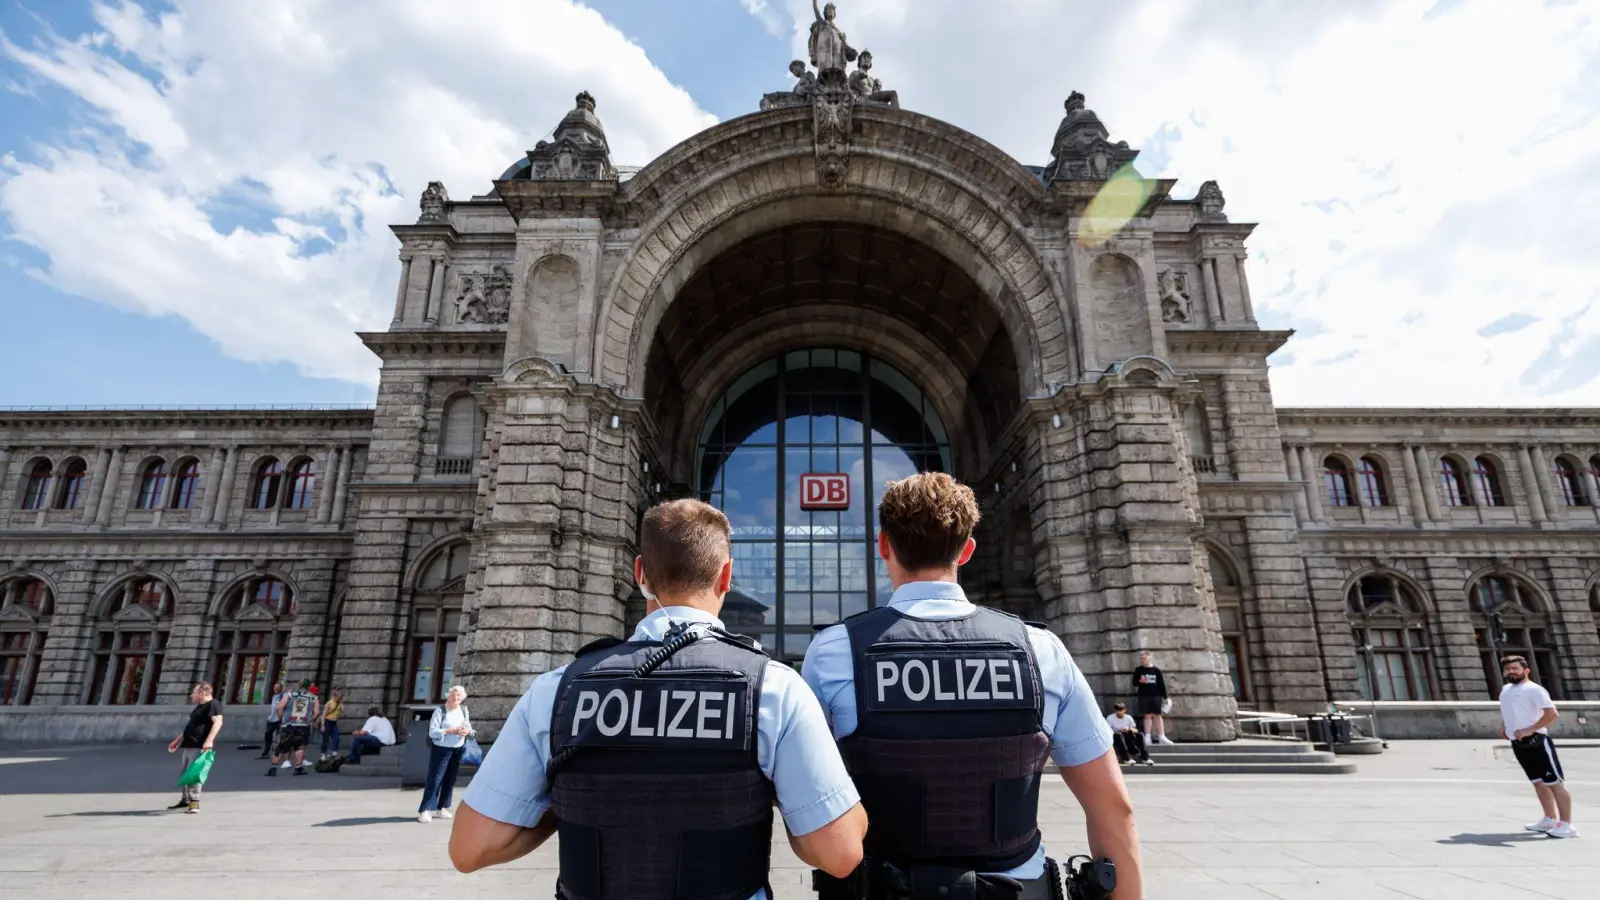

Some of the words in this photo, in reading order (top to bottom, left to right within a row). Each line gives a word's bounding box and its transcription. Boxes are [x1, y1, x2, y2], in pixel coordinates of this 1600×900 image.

[807, 479, 845, 502] DB
[876, 659, 1024, 702] POLIZEI
[571, 688, 736, 739] POLIZEI
